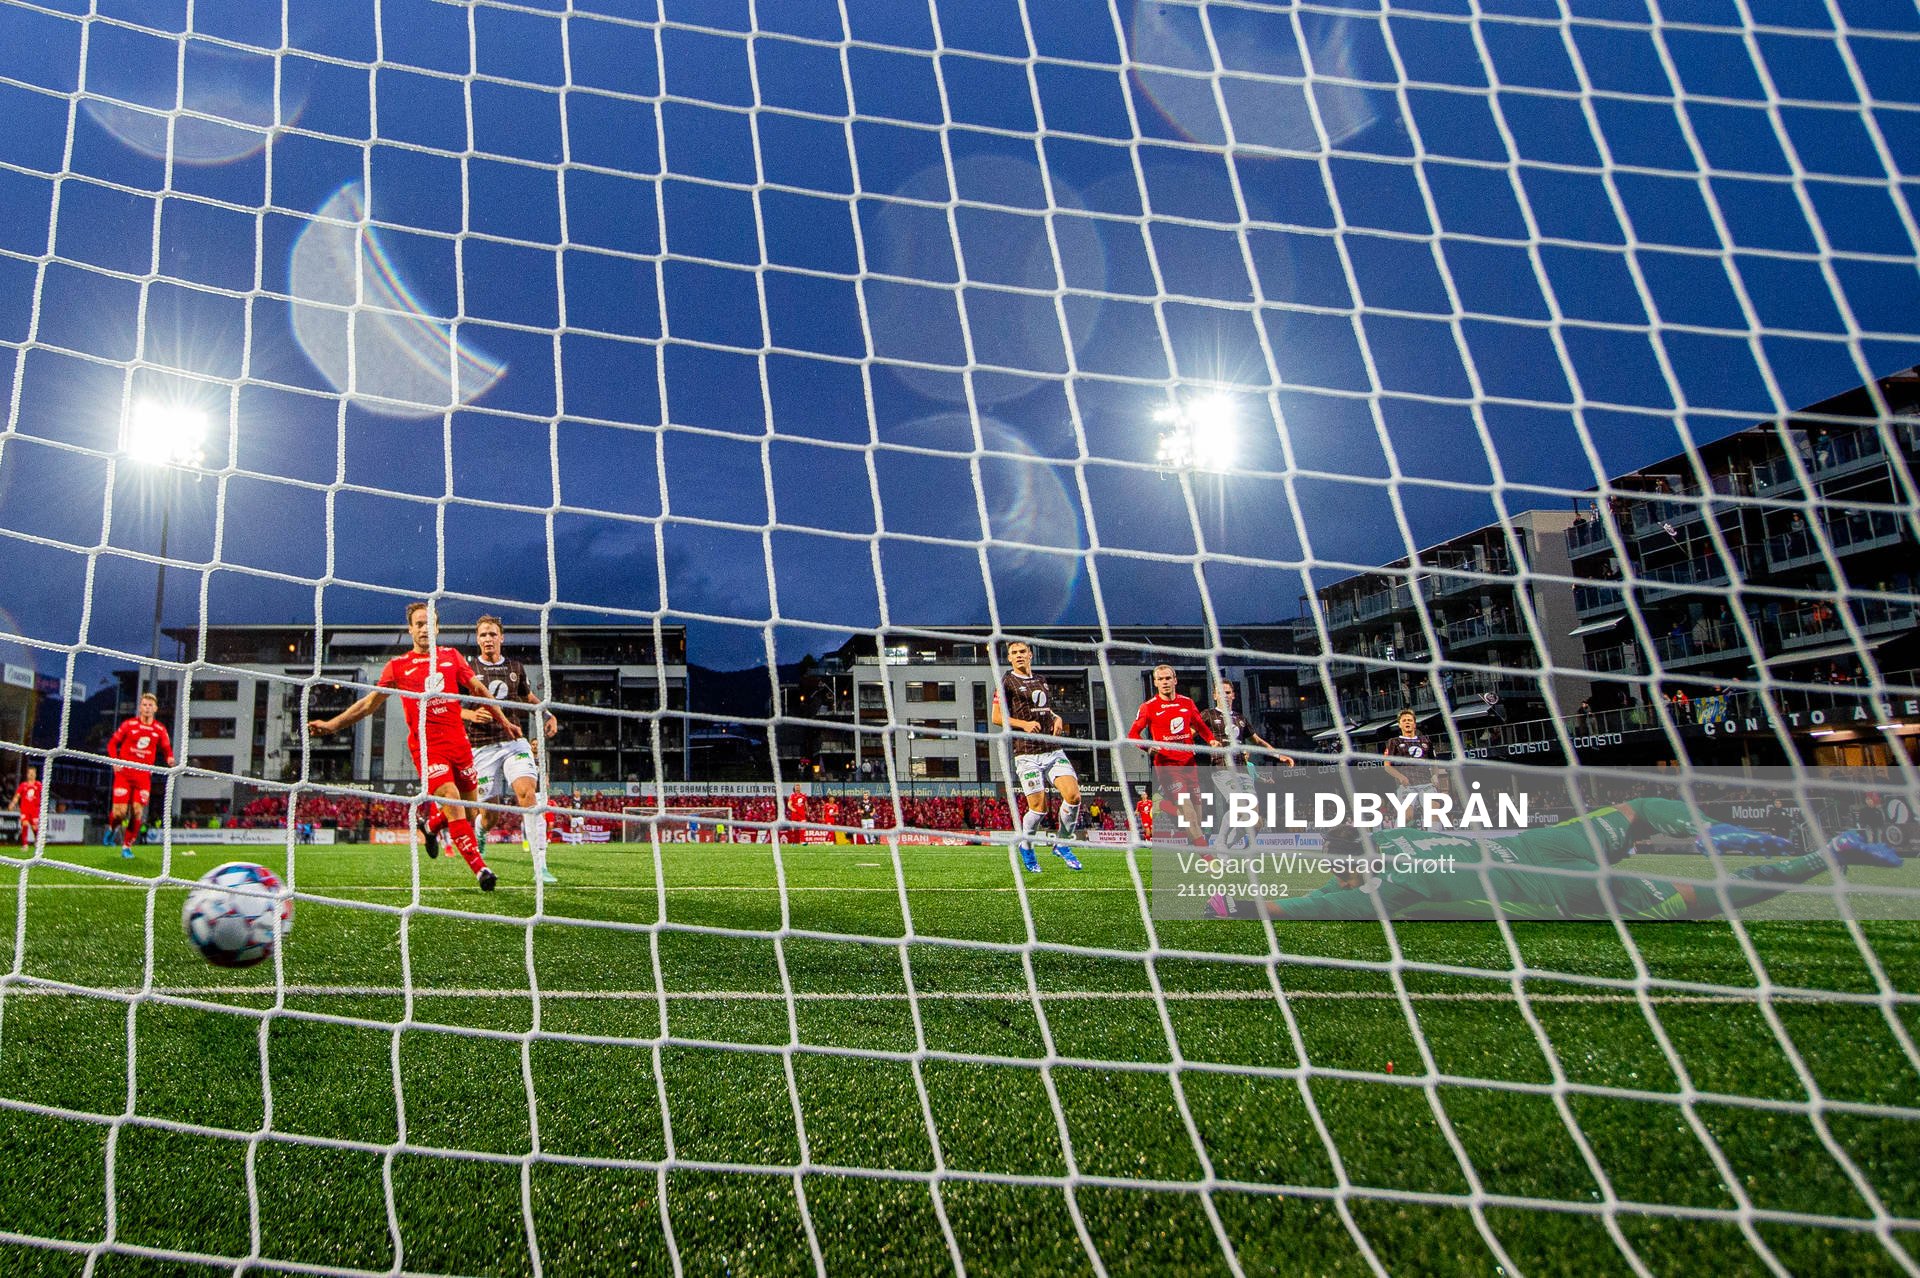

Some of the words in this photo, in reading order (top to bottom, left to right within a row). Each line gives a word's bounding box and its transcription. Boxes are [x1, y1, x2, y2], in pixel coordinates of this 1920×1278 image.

[1508, 741, 1549, 755] CONSTO
[1573, 733, 1622, 749] CONSTO
[720, 785, 734, 793] FRA
